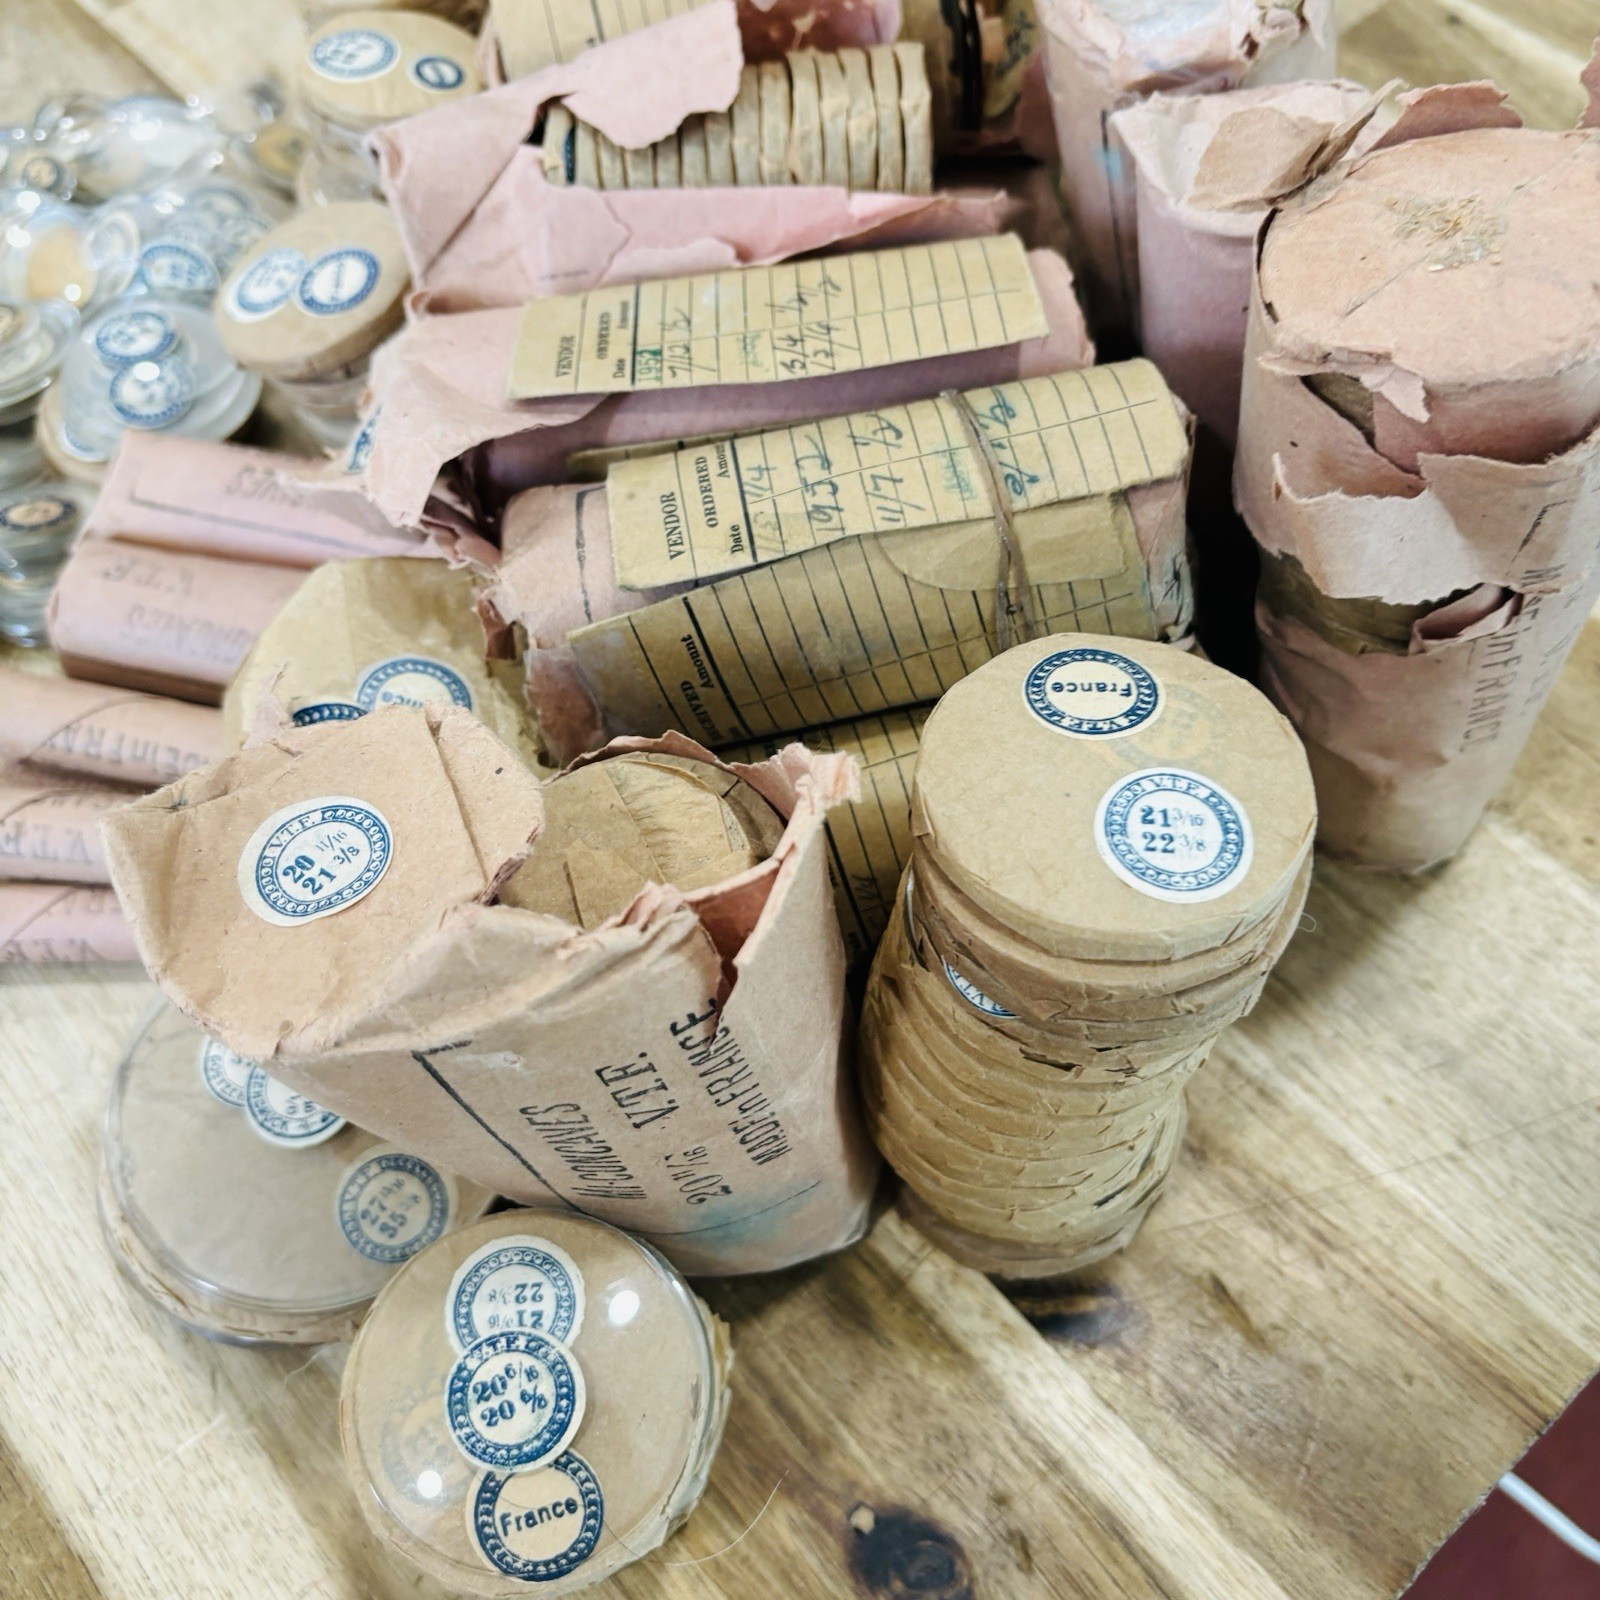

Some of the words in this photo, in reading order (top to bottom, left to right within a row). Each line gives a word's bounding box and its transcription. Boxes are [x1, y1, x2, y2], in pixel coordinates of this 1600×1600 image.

[555, 335, 576, 378] VENDOR
[612, 358, 627, 379] Date
[694, 455, 719, 529] ORDERED
[660, 491, 686, 561] VENDOR
[729, 524, 745, 555] Date
[680, 633, 715, 689] Amount
[1051, 681, 1133, 698] France
[268, 814, 316, 850] V.T.F.
[1140, 805, 1171, 828] 21
[1141, 831, 1175, 854] 22
[282, 854, 316, 884] 20
[302, 867, 337, 895] 21
[333, 846, 360, 866] 3/8
[669, 996, 761, 1107] FRANCE
[594, 1051, 681, 1130] V.T.F.
[514, 1281, 544, 1304] 22
[517, 1309, 545, 1329] 21
[472, 1372, 508, 1405] 20
[480, 1399, 516, 1428] 20
[499, 1495, 579, 1537] France
